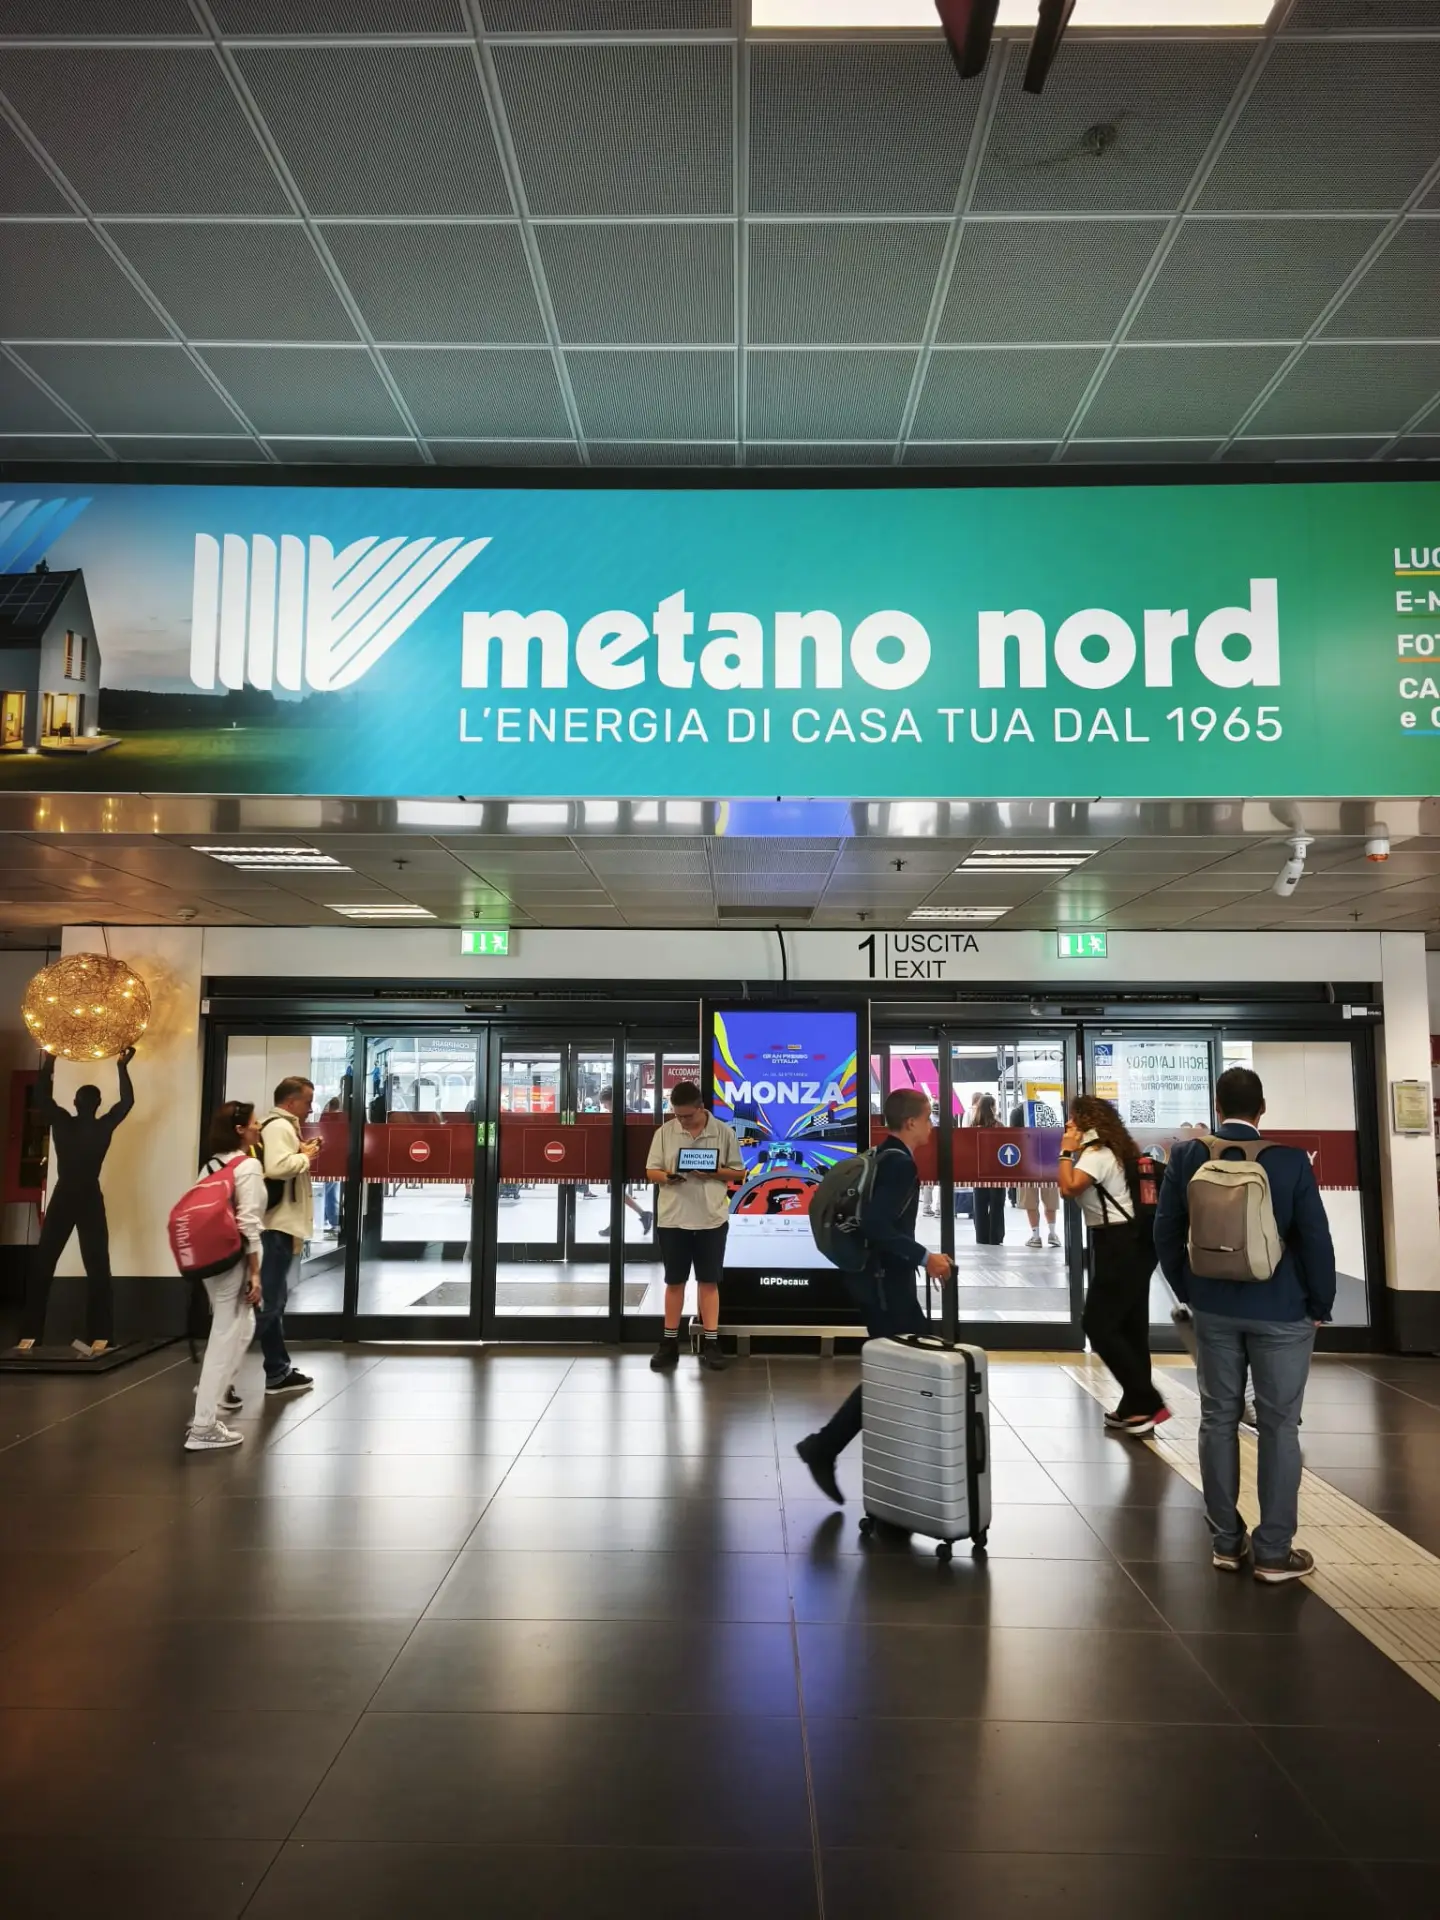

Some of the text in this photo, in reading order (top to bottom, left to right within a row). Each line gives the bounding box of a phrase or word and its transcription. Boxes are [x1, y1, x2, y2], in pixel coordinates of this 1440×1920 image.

[461, 577, 1281, 691] metano nord
[459, 706, 1283, 743] L'ENERGIA DI CASA TUA DAL 1965
[1400, 711, 1417, 728] e
[858, 934, 979, 978] 1 USCITA
[894, 960, 947, 978] EXIT
[724, 1081, 845, 1104] MONZA
[175, 1214, 191, 1248] PUMA
[759, 1277, 809, 1286] IGPDecaux
